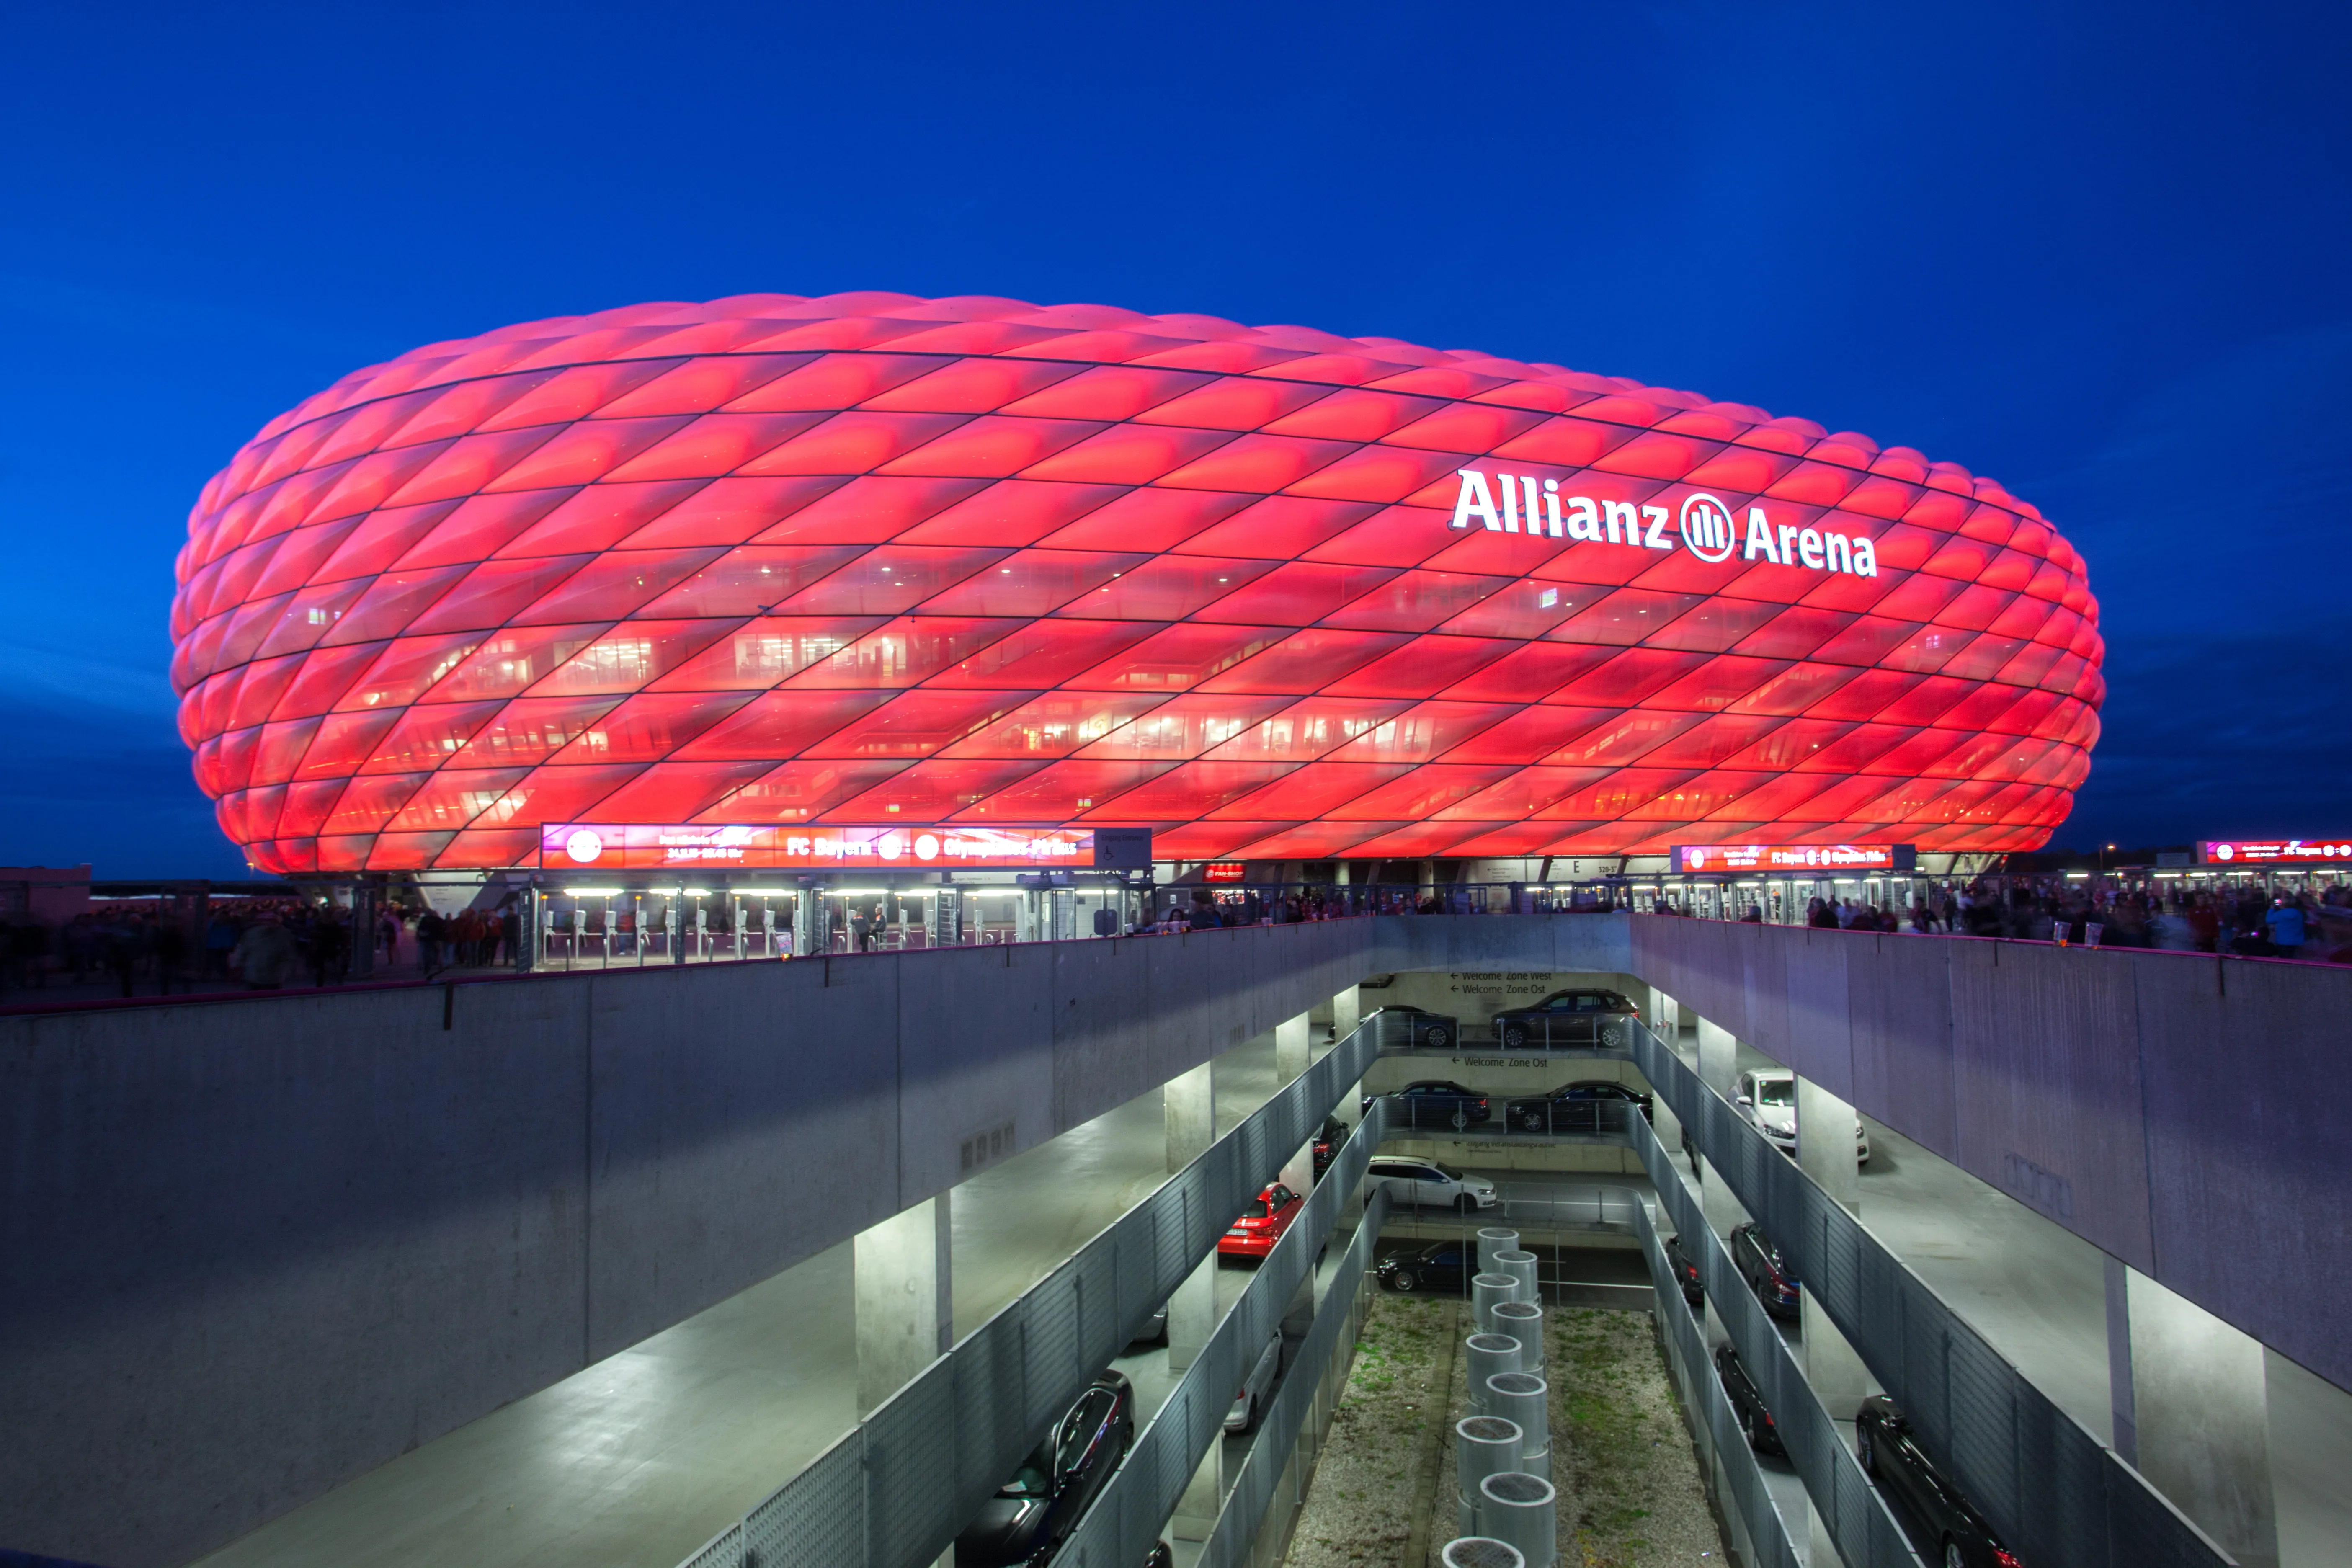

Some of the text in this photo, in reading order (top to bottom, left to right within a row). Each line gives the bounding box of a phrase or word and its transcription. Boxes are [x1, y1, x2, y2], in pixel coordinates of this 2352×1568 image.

[1452, 469, 1877, 577] Allianz Arena
[787, 837, 810, 855] FC
[815, 837, 872, 859] Bayern
[1573, 861, 1579, 873] E
[1462, 985, 1545, 994] Welcome Zone Ost
[1465, 1057, 1547, 1068] Welcome Zone Ost
